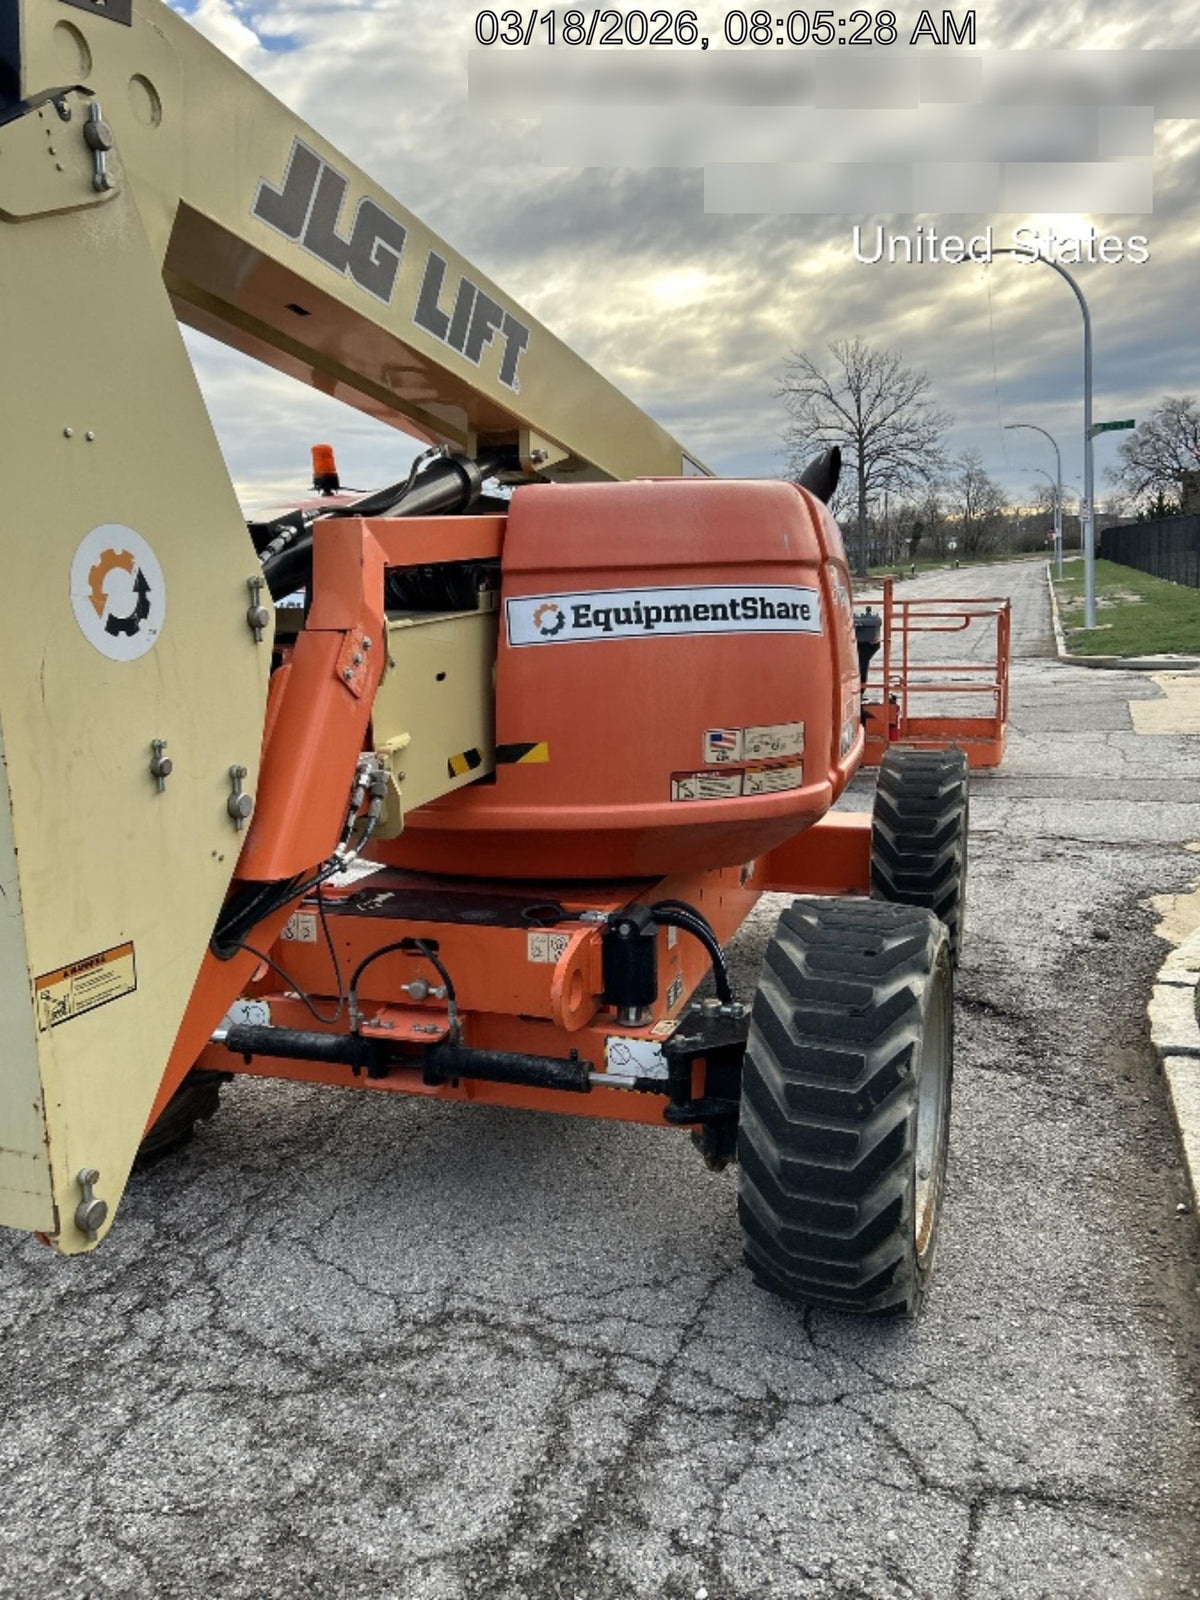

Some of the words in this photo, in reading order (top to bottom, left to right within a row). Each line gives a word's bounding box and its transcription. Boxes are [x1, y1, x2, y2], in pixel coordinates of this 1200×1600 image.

[250, 137, 408, 306] JLG
[412, 248, 530, 391] LIFT
[571, 597, 812, 632] EquipmentShare
